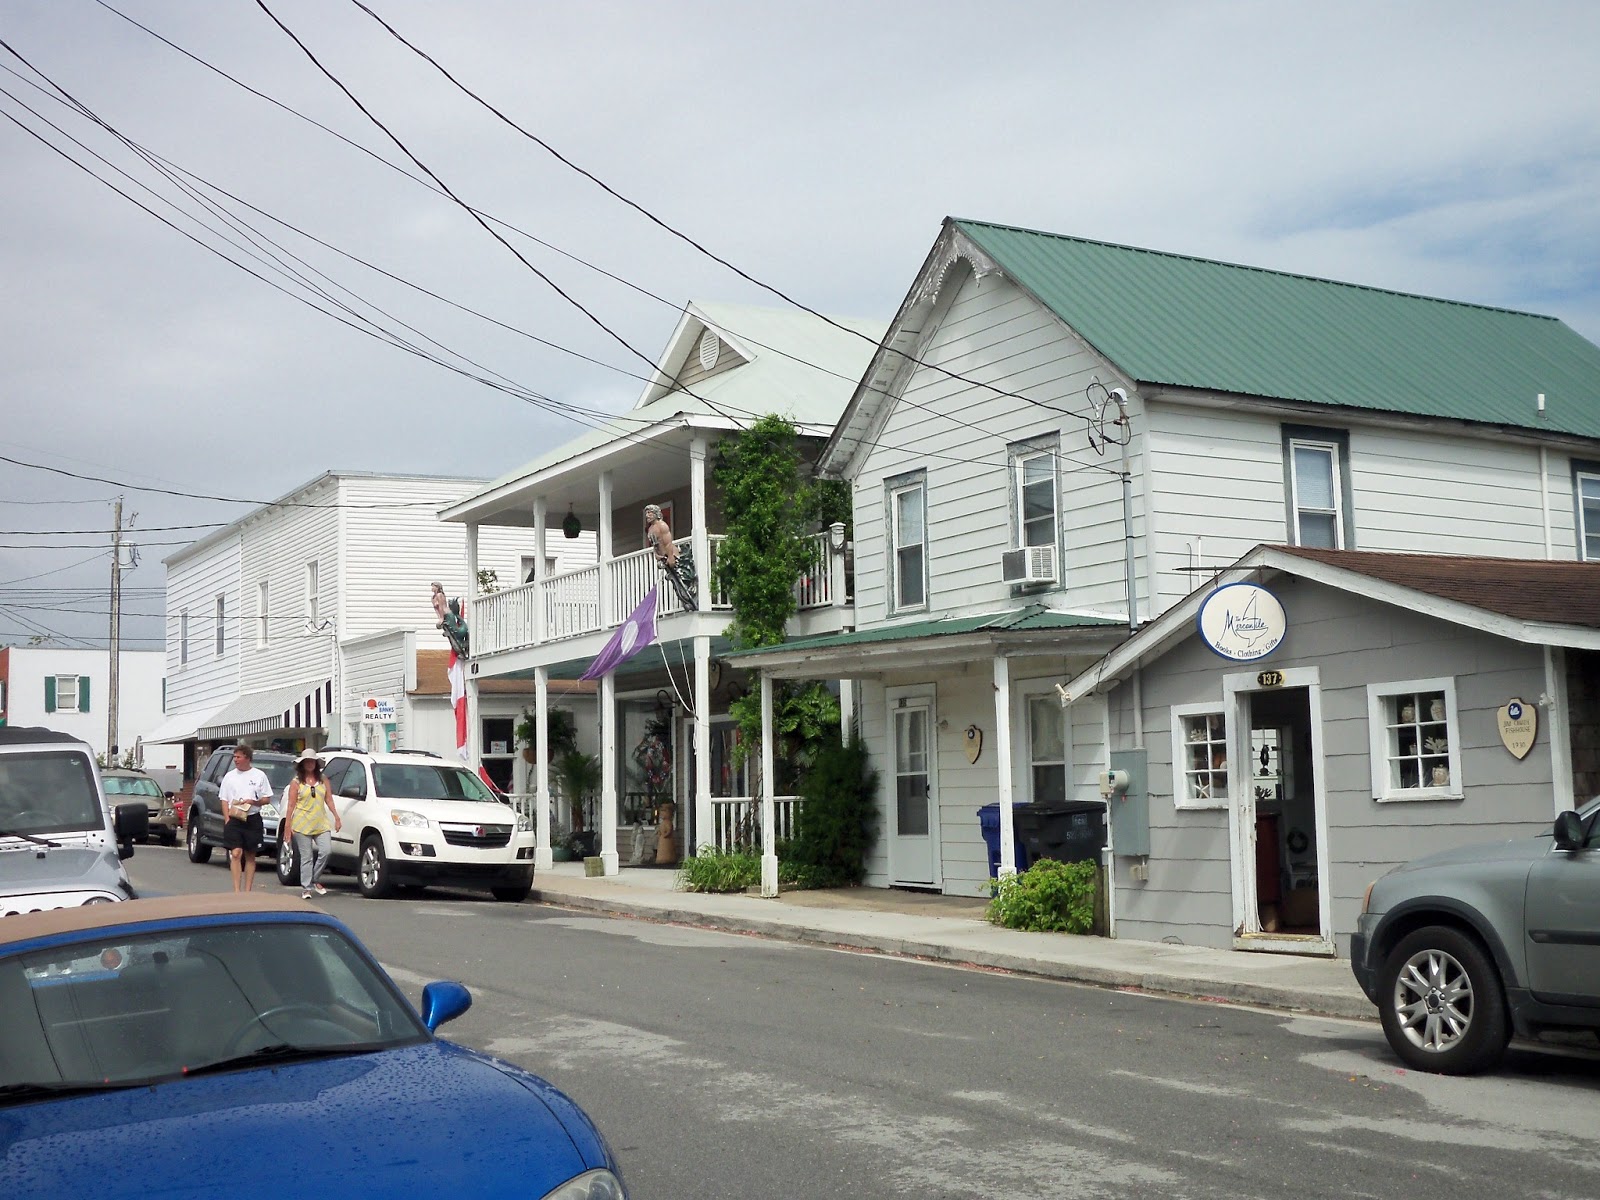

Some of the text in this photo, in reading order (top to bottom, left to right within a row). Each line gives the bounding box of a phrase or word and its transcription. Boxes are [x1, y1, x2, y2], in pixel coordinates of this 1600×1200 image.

[1215, 638, 1279, 658] Books Clothing Gifts
[1262, 673, 1278, 685] 137
